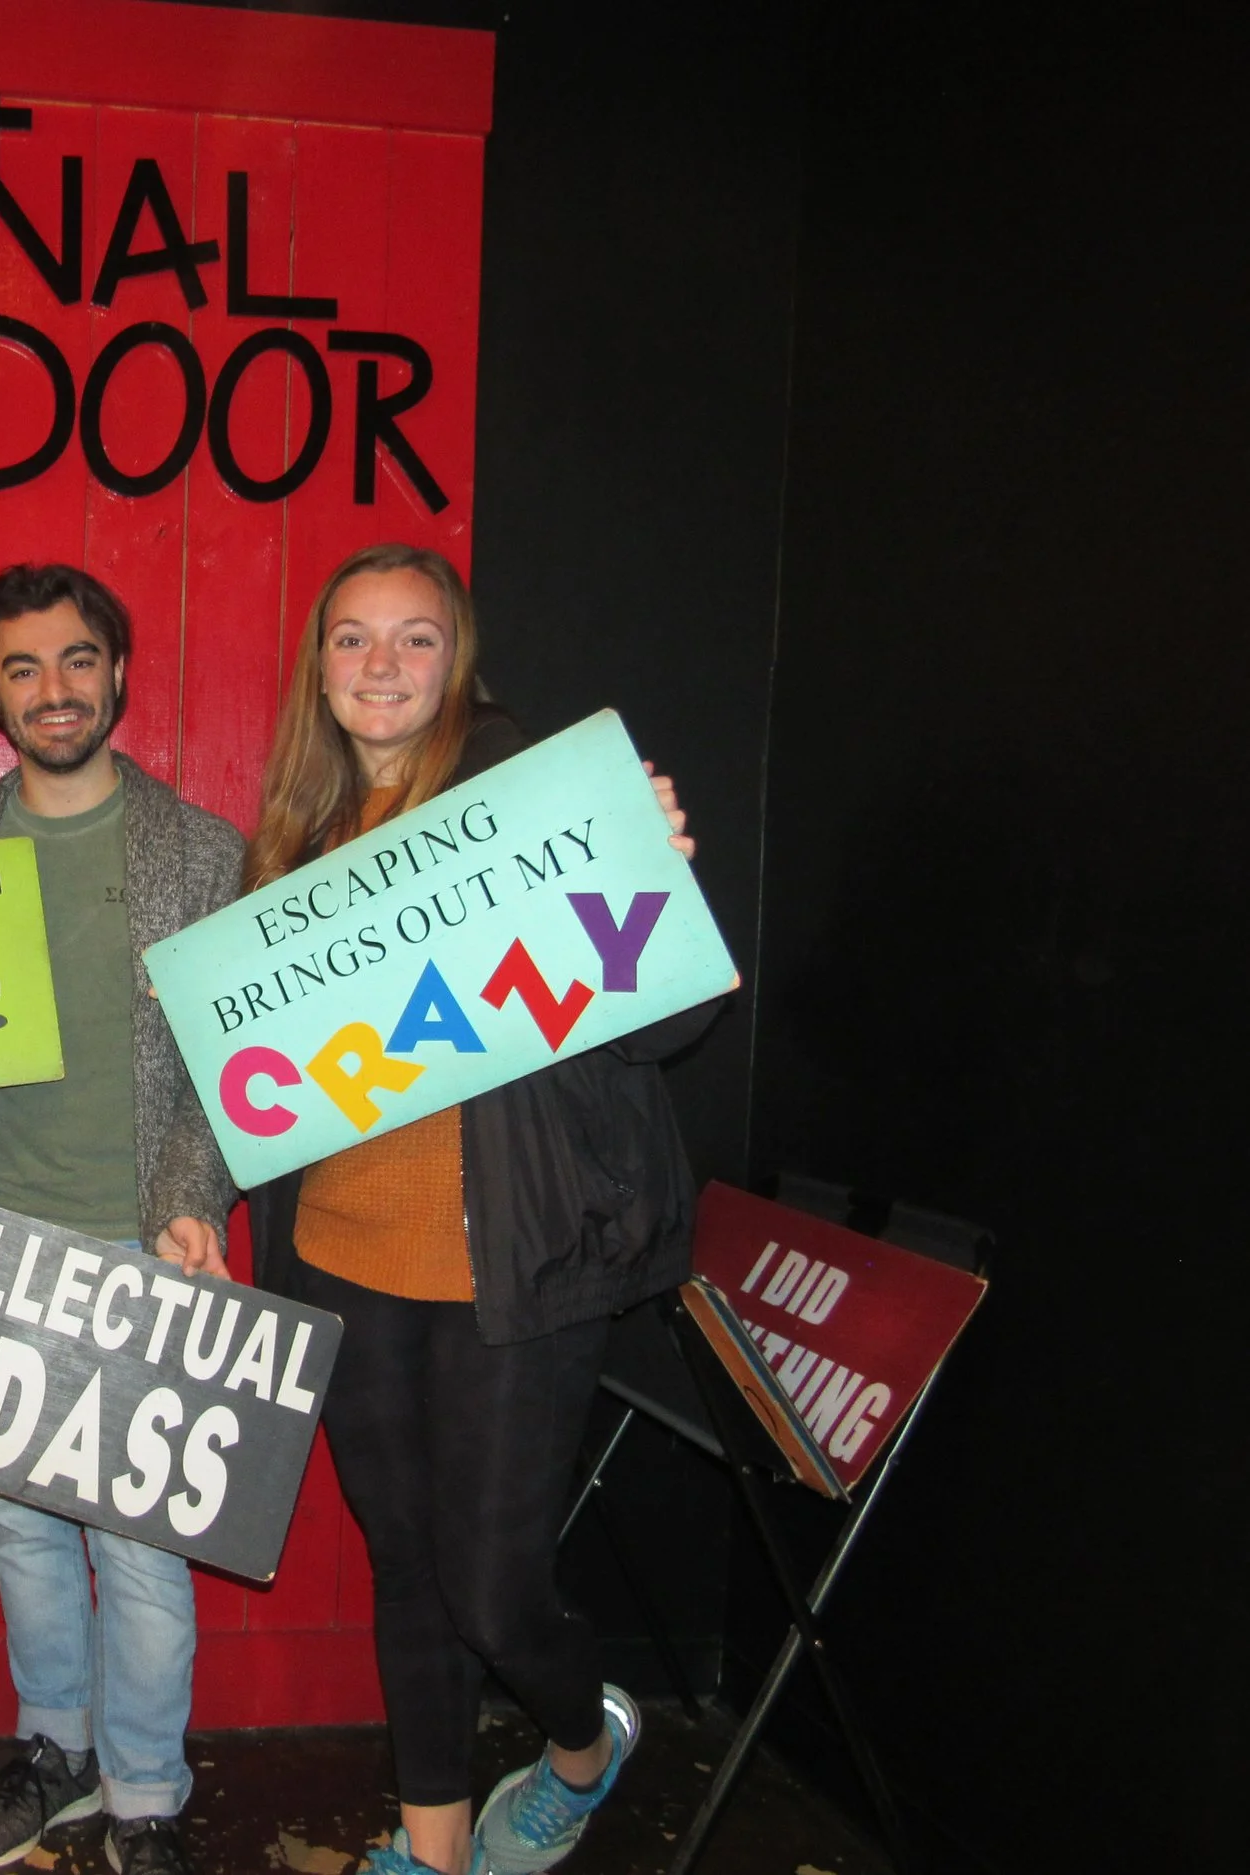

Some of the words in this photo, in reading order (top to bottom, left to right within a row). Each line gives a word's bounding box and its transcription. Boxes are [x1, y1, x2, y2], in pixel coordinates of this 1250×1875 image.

[210, 925, 387, 1034] BRINGS
[396, 867, 503, 944] OUT
[510, 817, 599, 892] MY
[254, 800, 499, 948] ESCAPING
[219, 892, 671, 1137] CRAZY
[740, 1241, 779, 1294] I
[760, 1249, 849, 1326] DID
